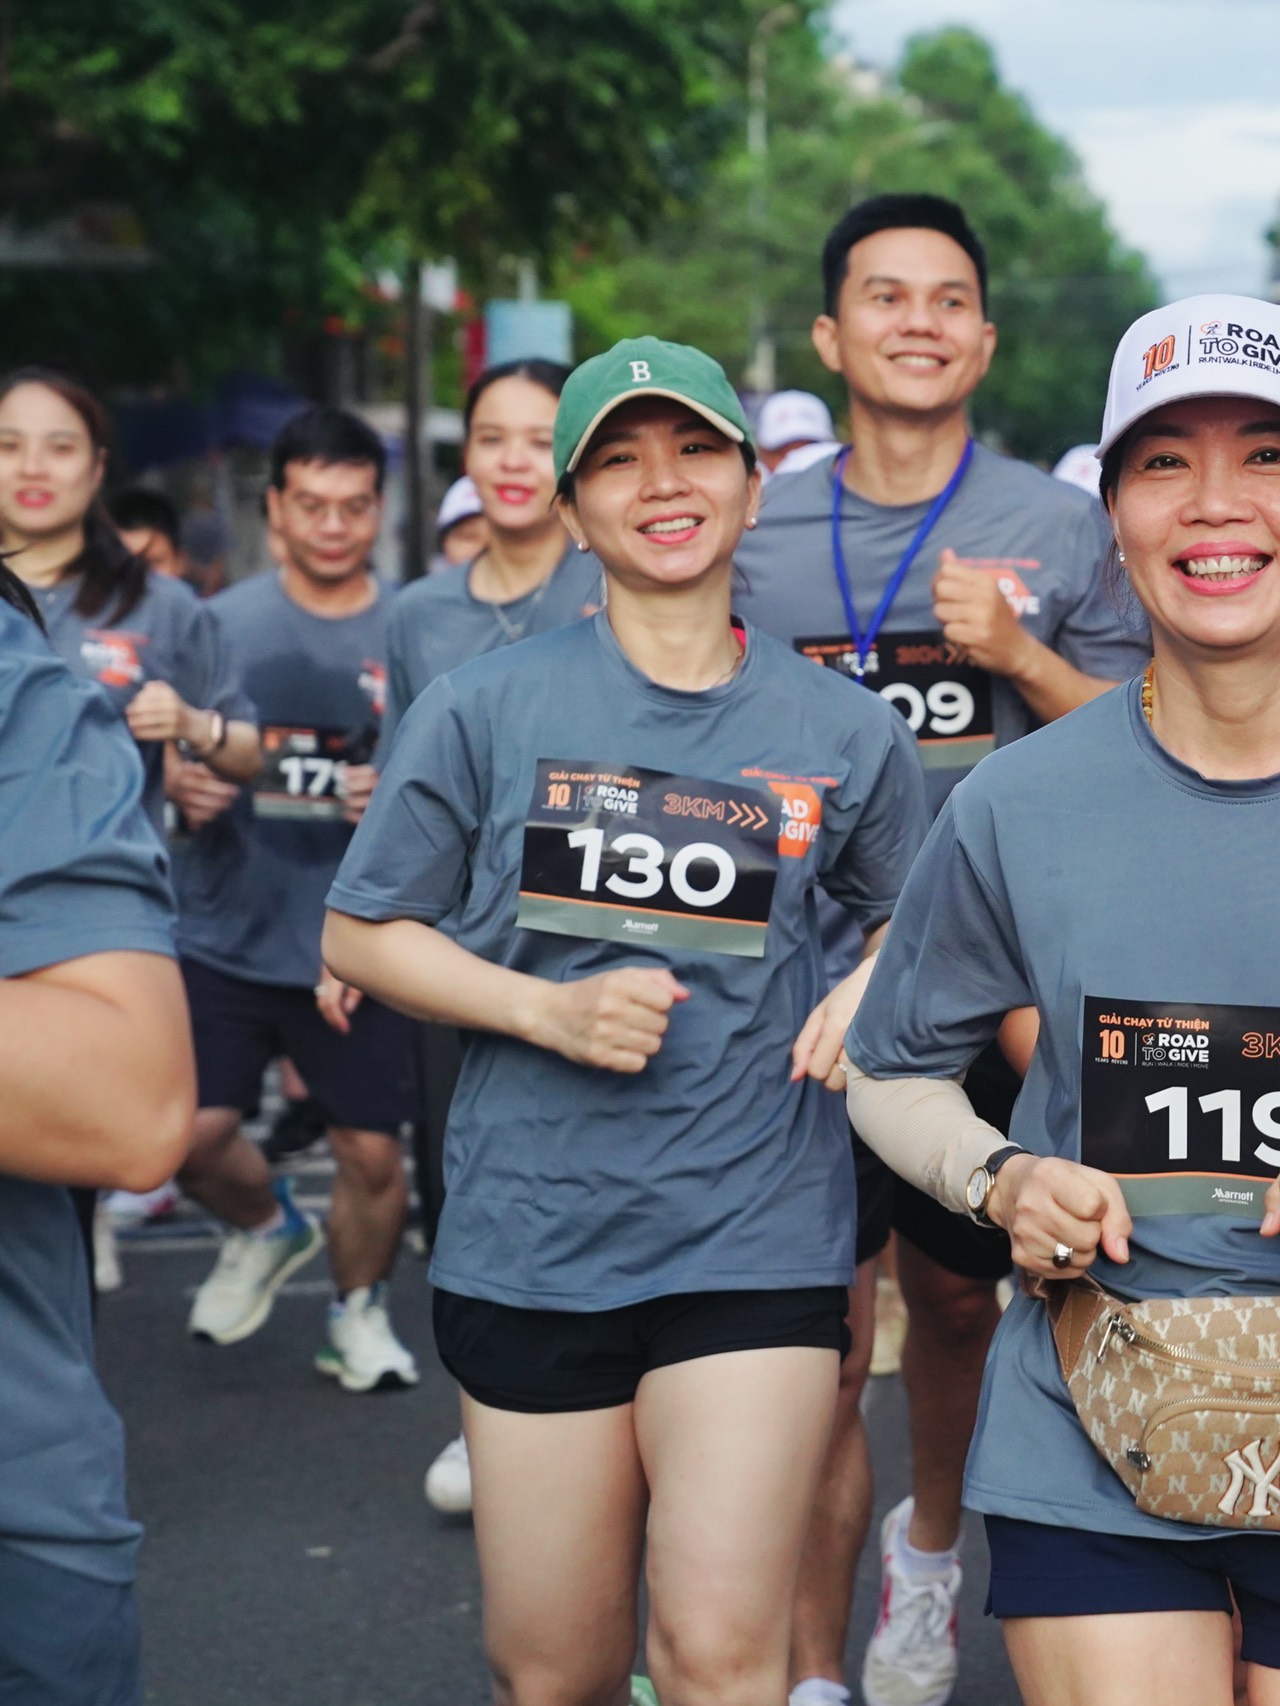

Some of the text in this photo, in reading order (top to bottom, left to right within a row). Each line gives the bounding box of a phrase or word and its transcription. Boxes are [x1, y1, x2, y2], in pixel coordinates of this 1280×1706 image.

[1143, 335, 1175, 379] 10
[1200, 338, 1239, 356] TO
[629, 361, 651, 382] B
[547, 783, 571, 807] 10
[596, 785, 639, 802] ROAD
[603, 798, 638, 814] GIVE
[662, 793, 726, 821] 3KM
[567, 827, 737, 908] 130
[1099, 1012, 1210, 1031] GIẢI CHẠY TỪ THIỆN
[1099, 1029, 1125, 1059] 10
[1158, 1033, 1209, 1049] ROAD
[1142, 1046, 1210, 1063] TO GIVE
[1211, 1188, 1254, 1202] Marriott
[1172, 1298, 1193, 1317] N
[1153, 1317, 1172, 1340] Y
[1192, 1312, 1213, 1339] Y
[1234, 1308, 1253, 1335] Y
[1216, 1336, 1238, 1361] N
[1257, 1334, 1278, 1359] N
[1082, 1350, 1170, 1399] N Y Y
[1091, 1371, 1148, 1446] N N Y N
[1194, 1410, 1211, 1431] Y
[1234, 1411, 1251, 1434] Y
[1170, 1431, 1191, 1452] N
[1212, 1432, 1233, 1452] N
[1150, 1451, 1209, 1476] Y Y
[1168, 1473, 1230, 1495] N N
[1147, 1494, 1204, 1512] Y Y
